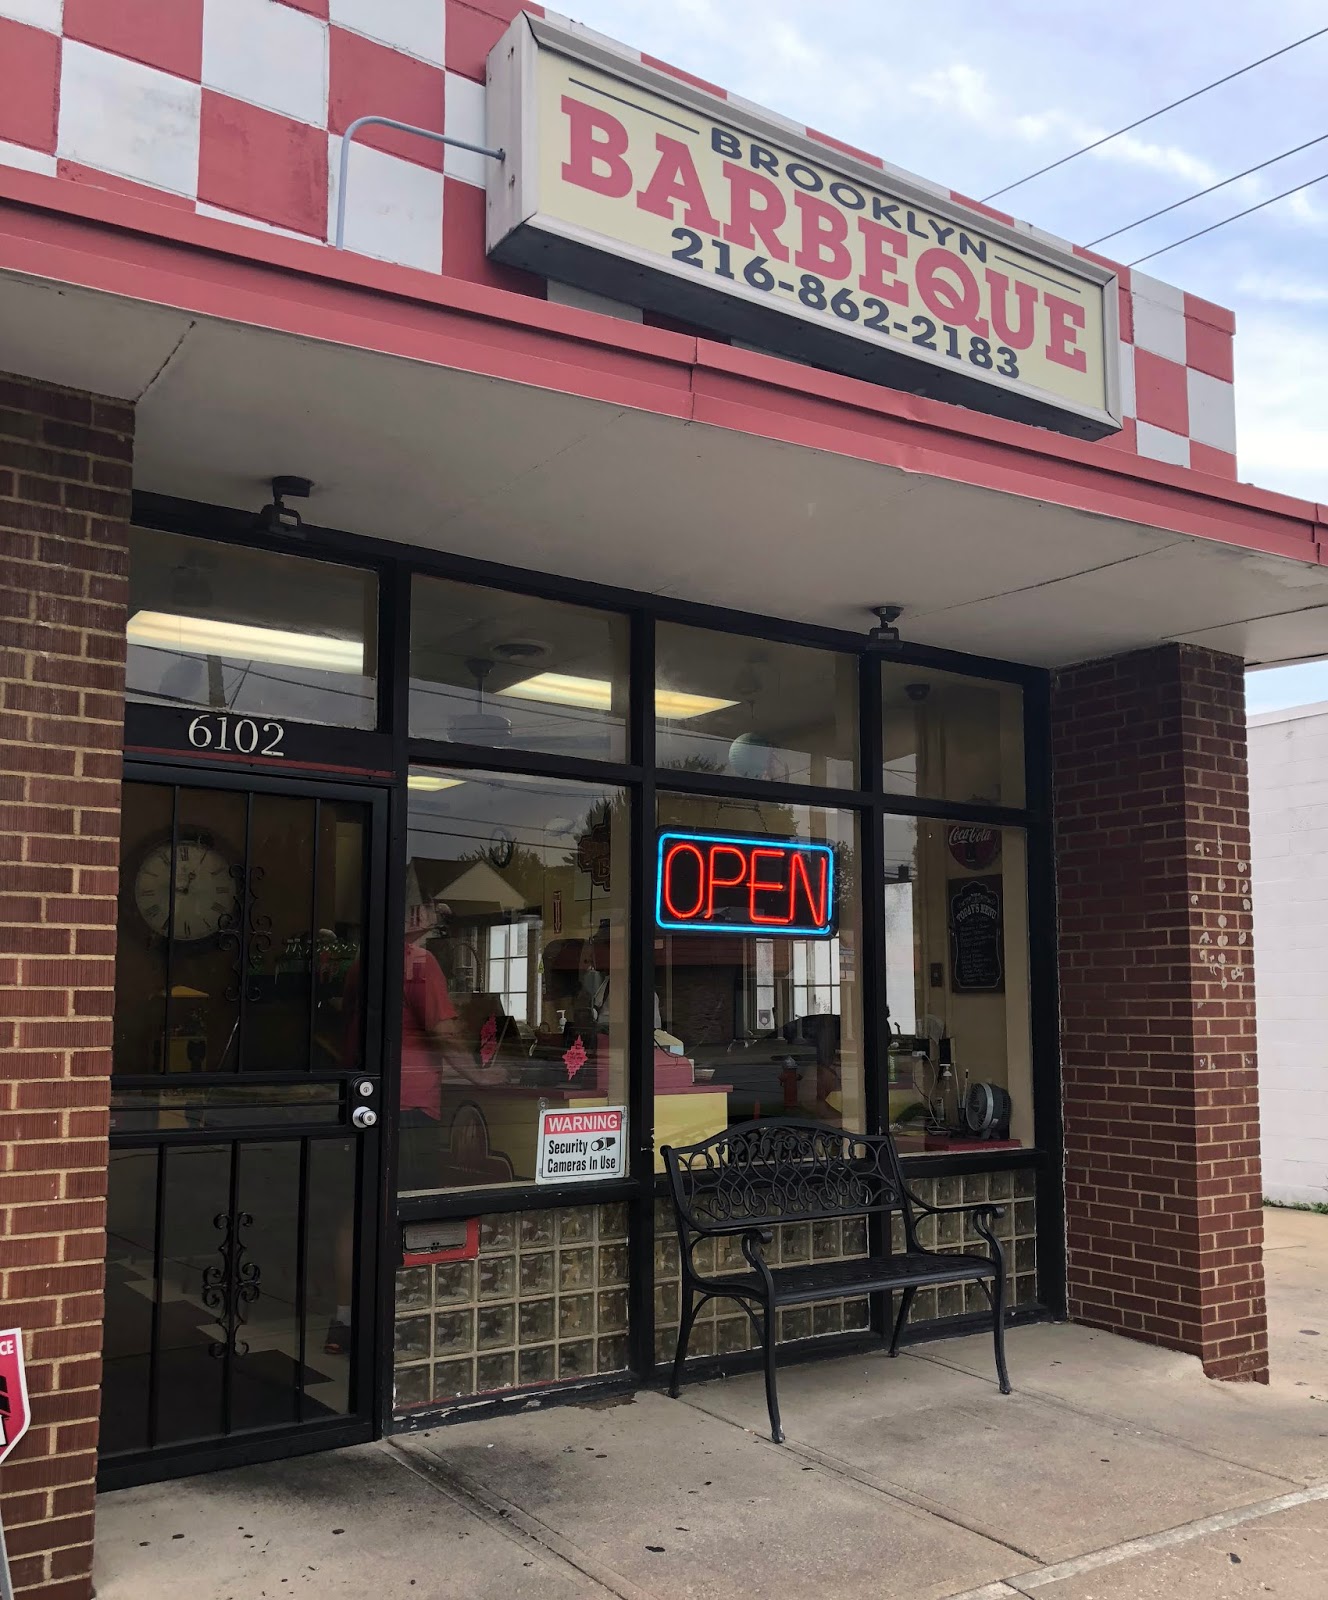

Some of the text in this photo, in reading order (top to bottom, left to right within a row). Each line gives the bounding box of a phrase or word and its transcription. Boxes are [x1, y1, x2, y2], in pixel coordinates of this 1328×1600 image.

[711, 127, 988, 263] BROOKLYN
[561, 95, 1087, 373] BARBEQUE
[672, 228, 1020, 379] 216-862-2183
[188, 715, 284, 757] 6102
[664, 842, 825, 926] OPEN
[548, 1114, 618, 1132] WARNING
[548, 1138, 588, 1155] Security
[547, 1154, 616, 1173] Cameras In Use
